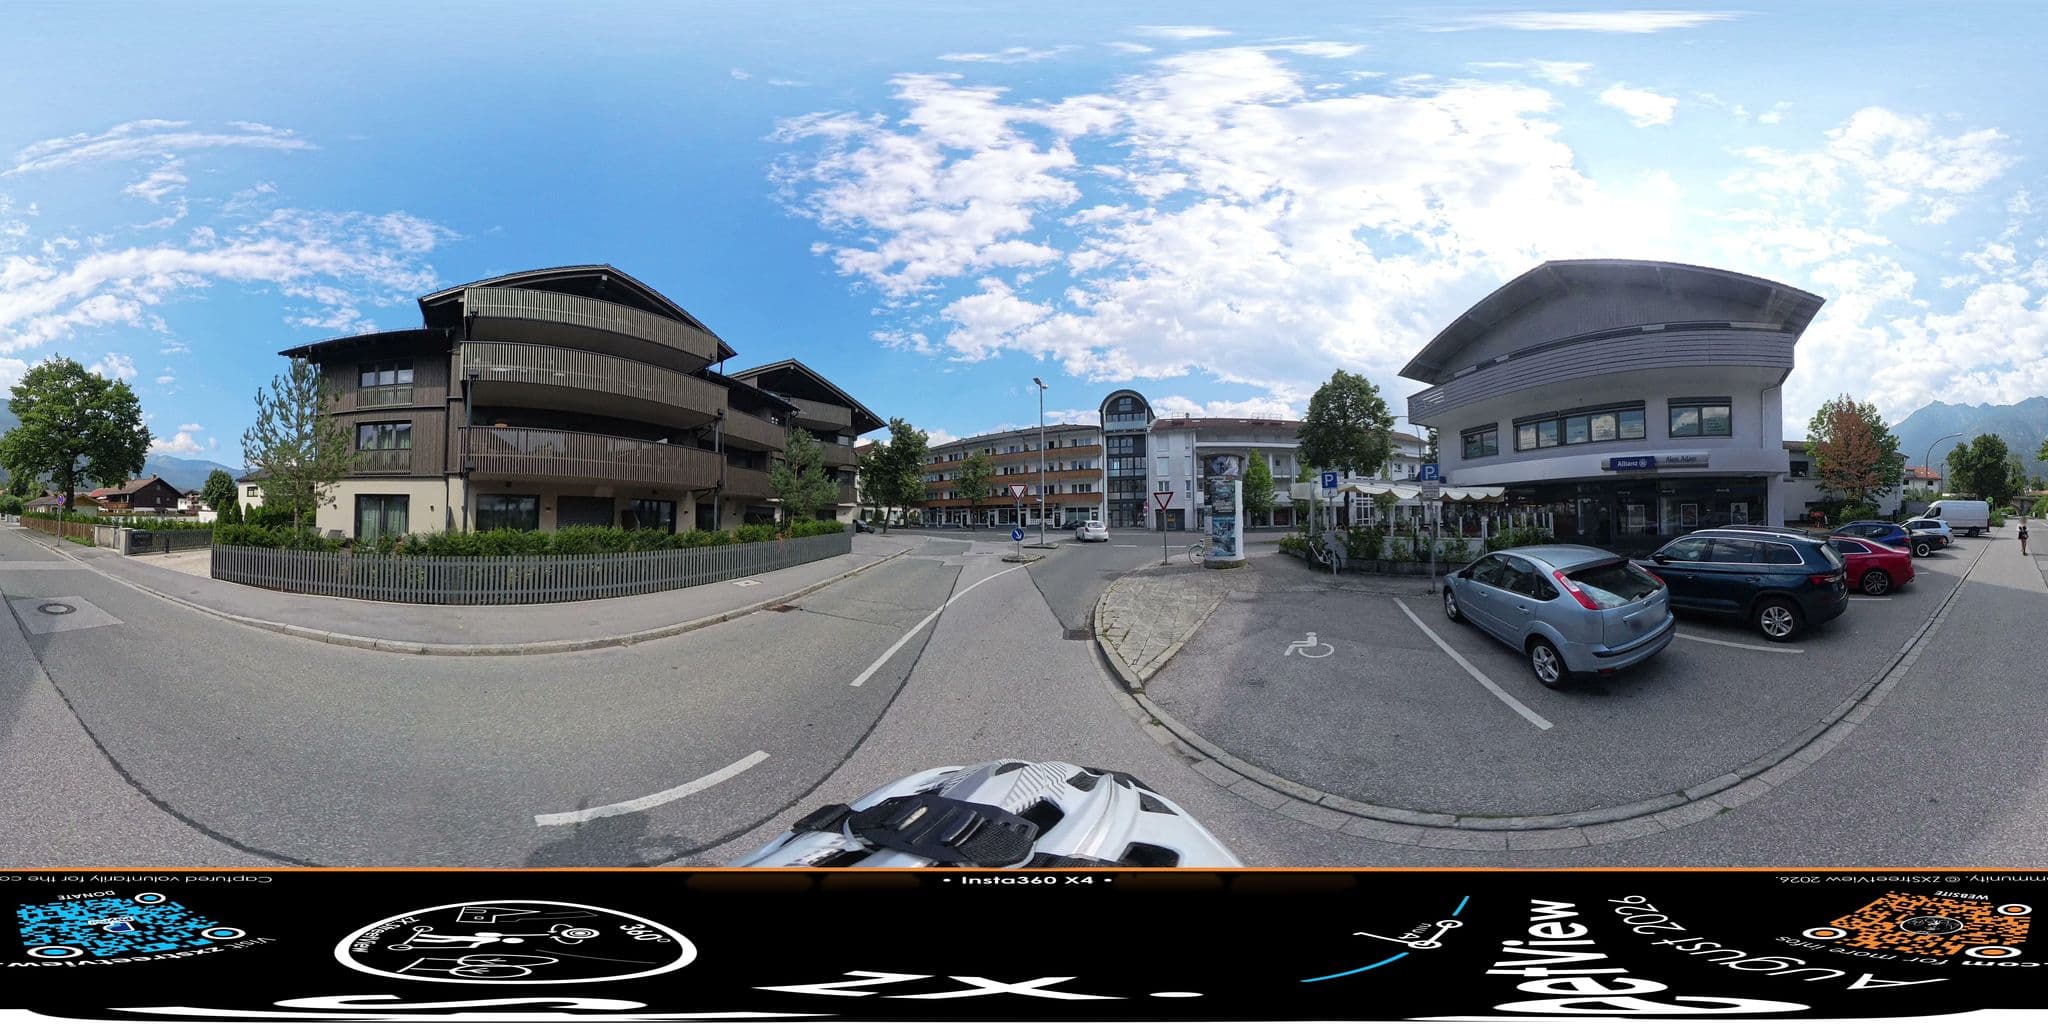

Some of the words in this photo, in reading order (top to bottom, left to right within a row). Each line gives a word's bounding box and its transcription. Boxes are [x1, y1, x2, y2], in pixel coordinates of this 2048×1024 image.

[1617, 460, 1638, 468] Allianz
[1425, 466, 1435, 480] P
[1325, 474, 1334, 486] P
